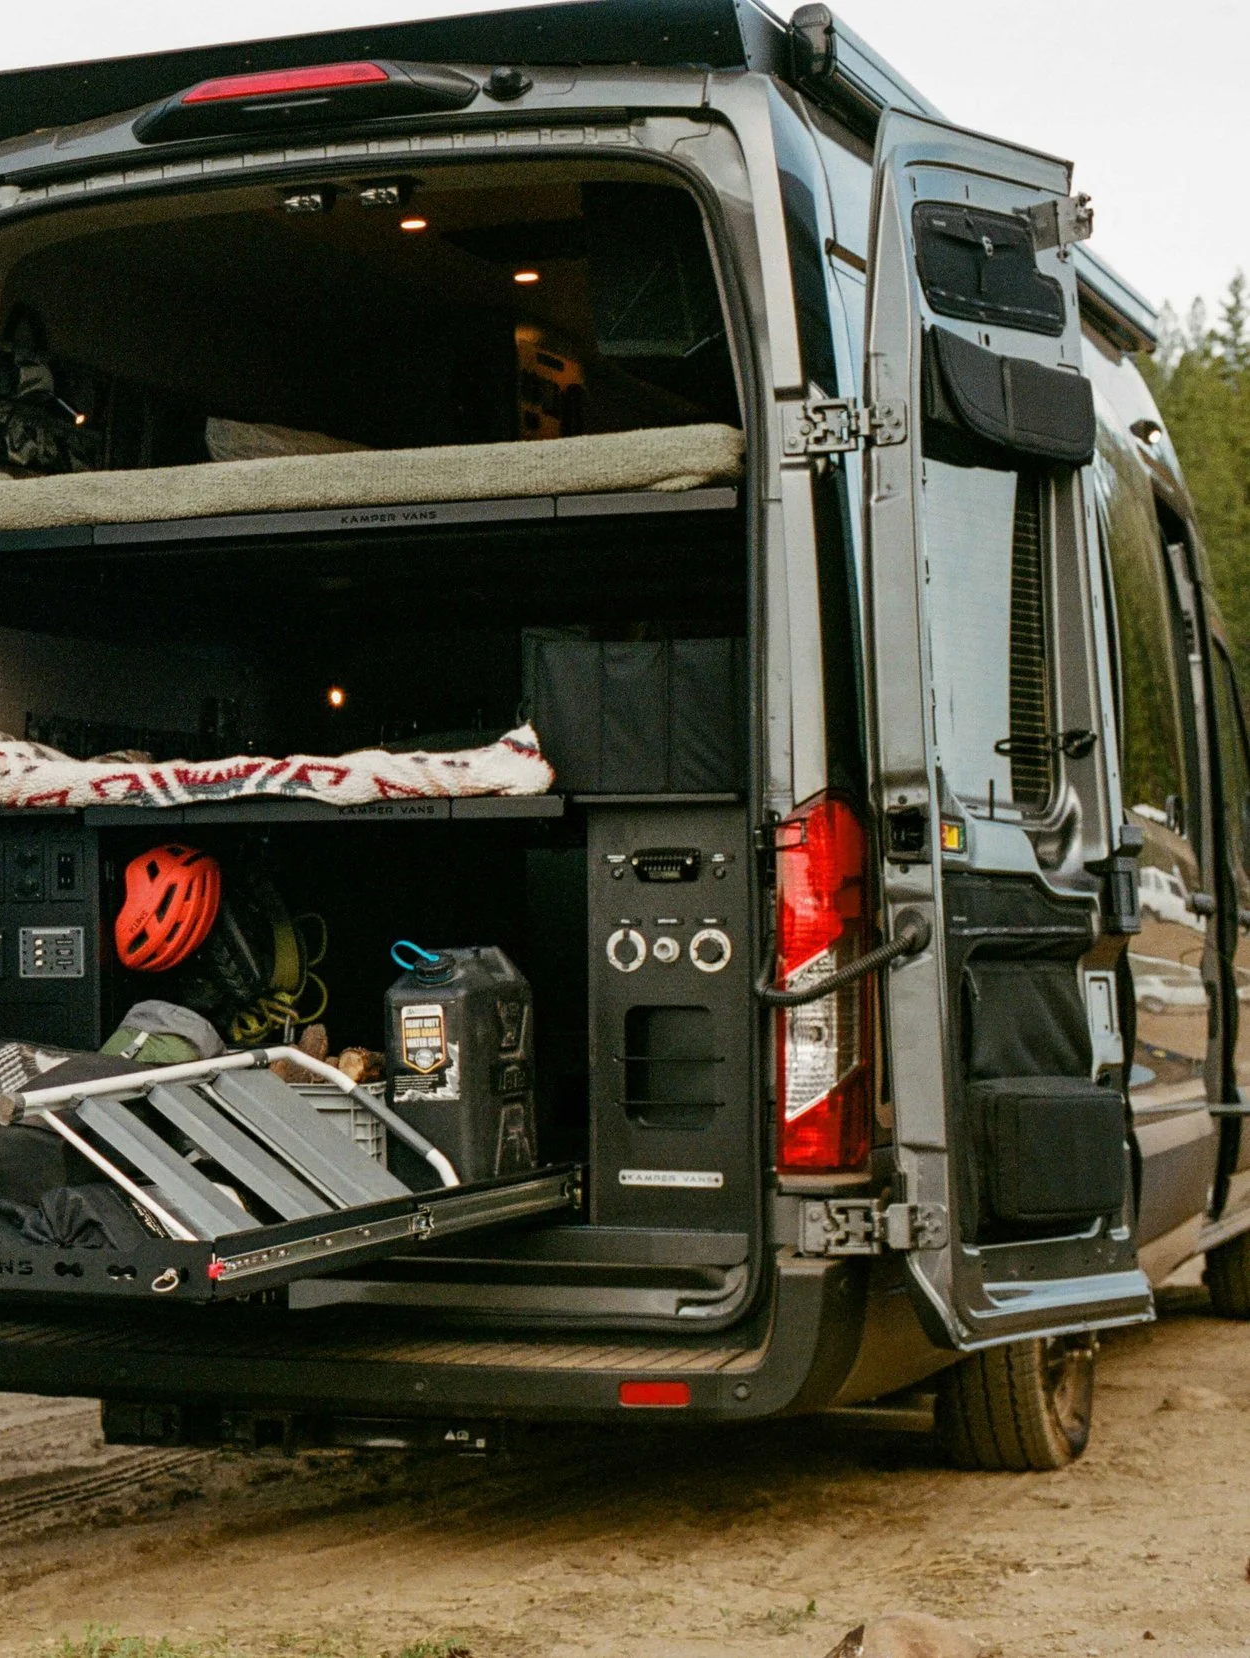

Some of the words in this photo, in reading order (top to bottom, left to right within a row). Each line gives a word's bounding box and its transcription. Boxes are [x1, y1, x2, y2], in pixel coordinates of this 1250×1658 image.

[341, 513, 396, 523] KAMPER
[403, 511, 437, 520] VANS
[338, 805, 393, 815] KAMPER
[400, 806, 435, 814] VANS
